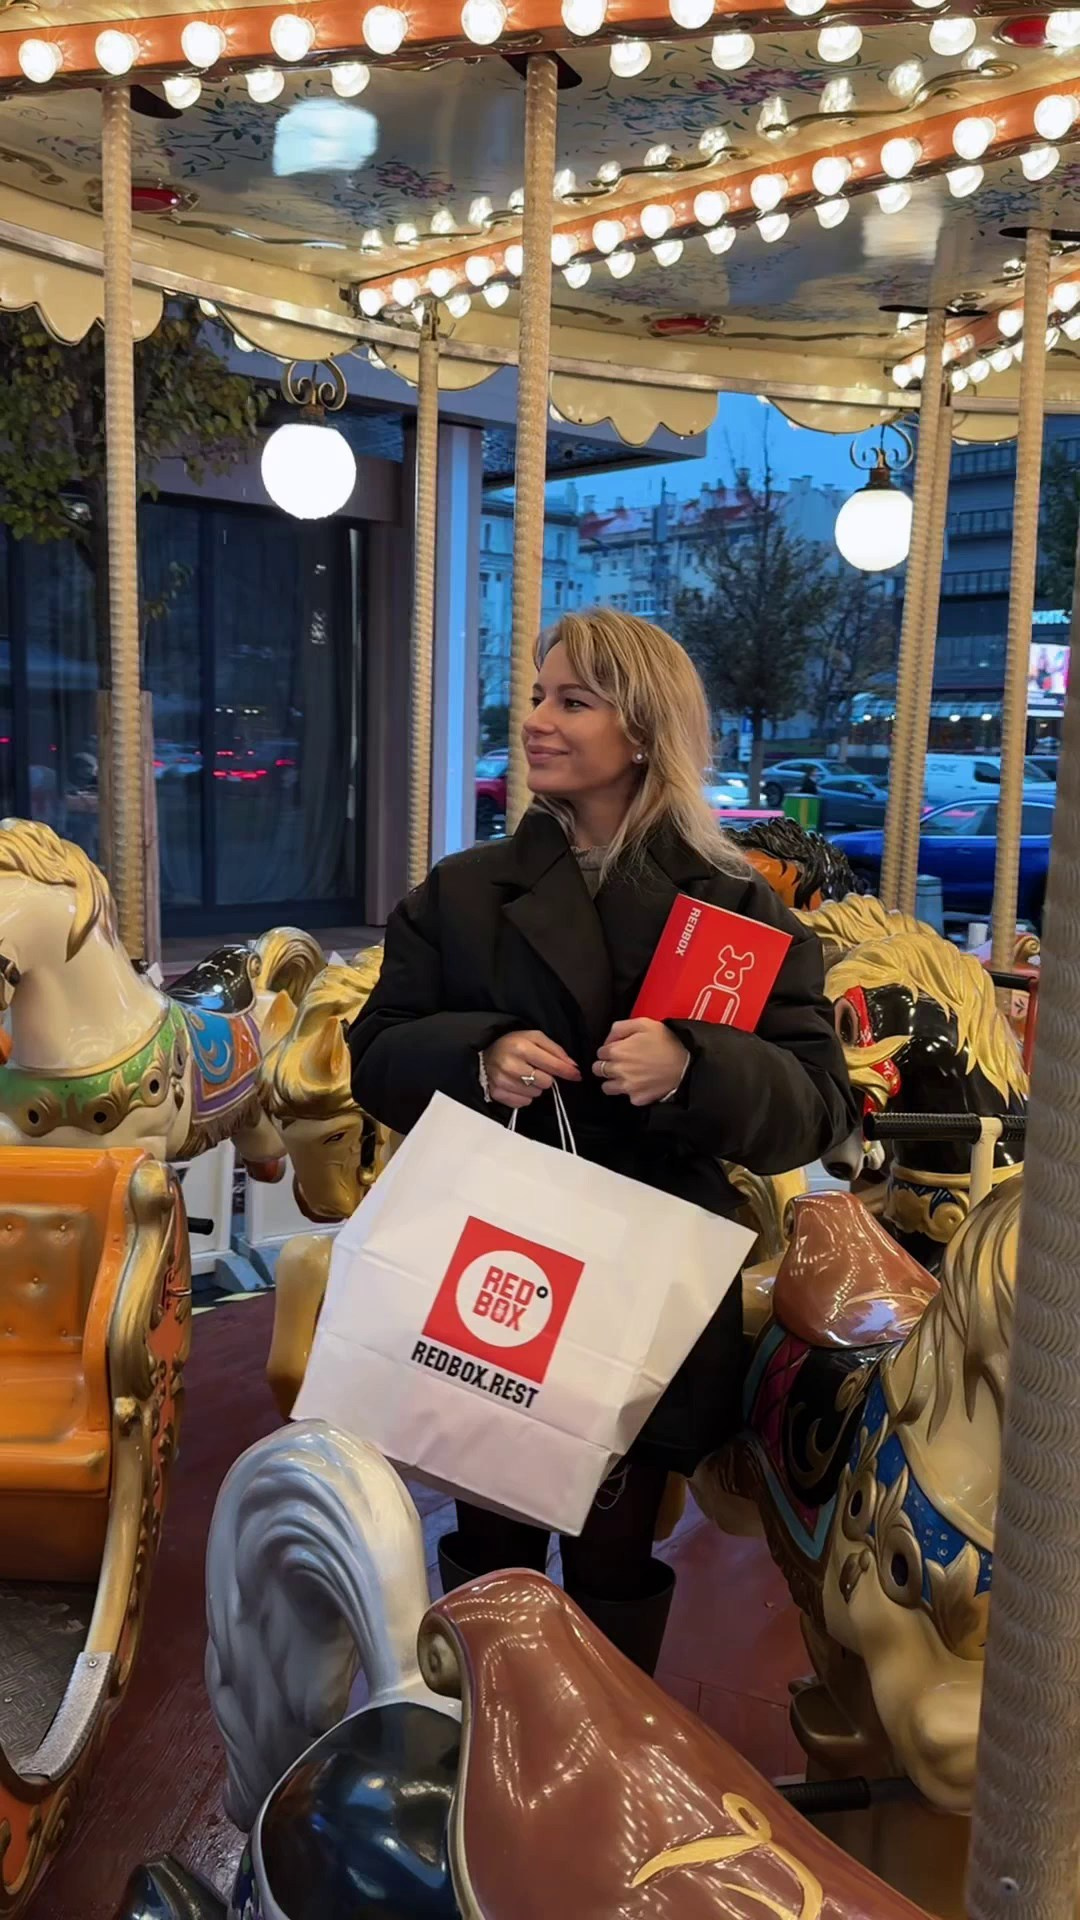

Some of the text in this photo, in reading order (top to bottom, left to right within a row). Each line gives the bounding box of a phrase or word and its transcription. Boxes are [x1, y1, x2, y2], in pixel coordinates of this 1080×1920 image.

[675, 907, 702, 957] REDBOX
[472, 1290, 527, 1331] BOX
[410, 1340, 540, 1409] REDBOX.REST
